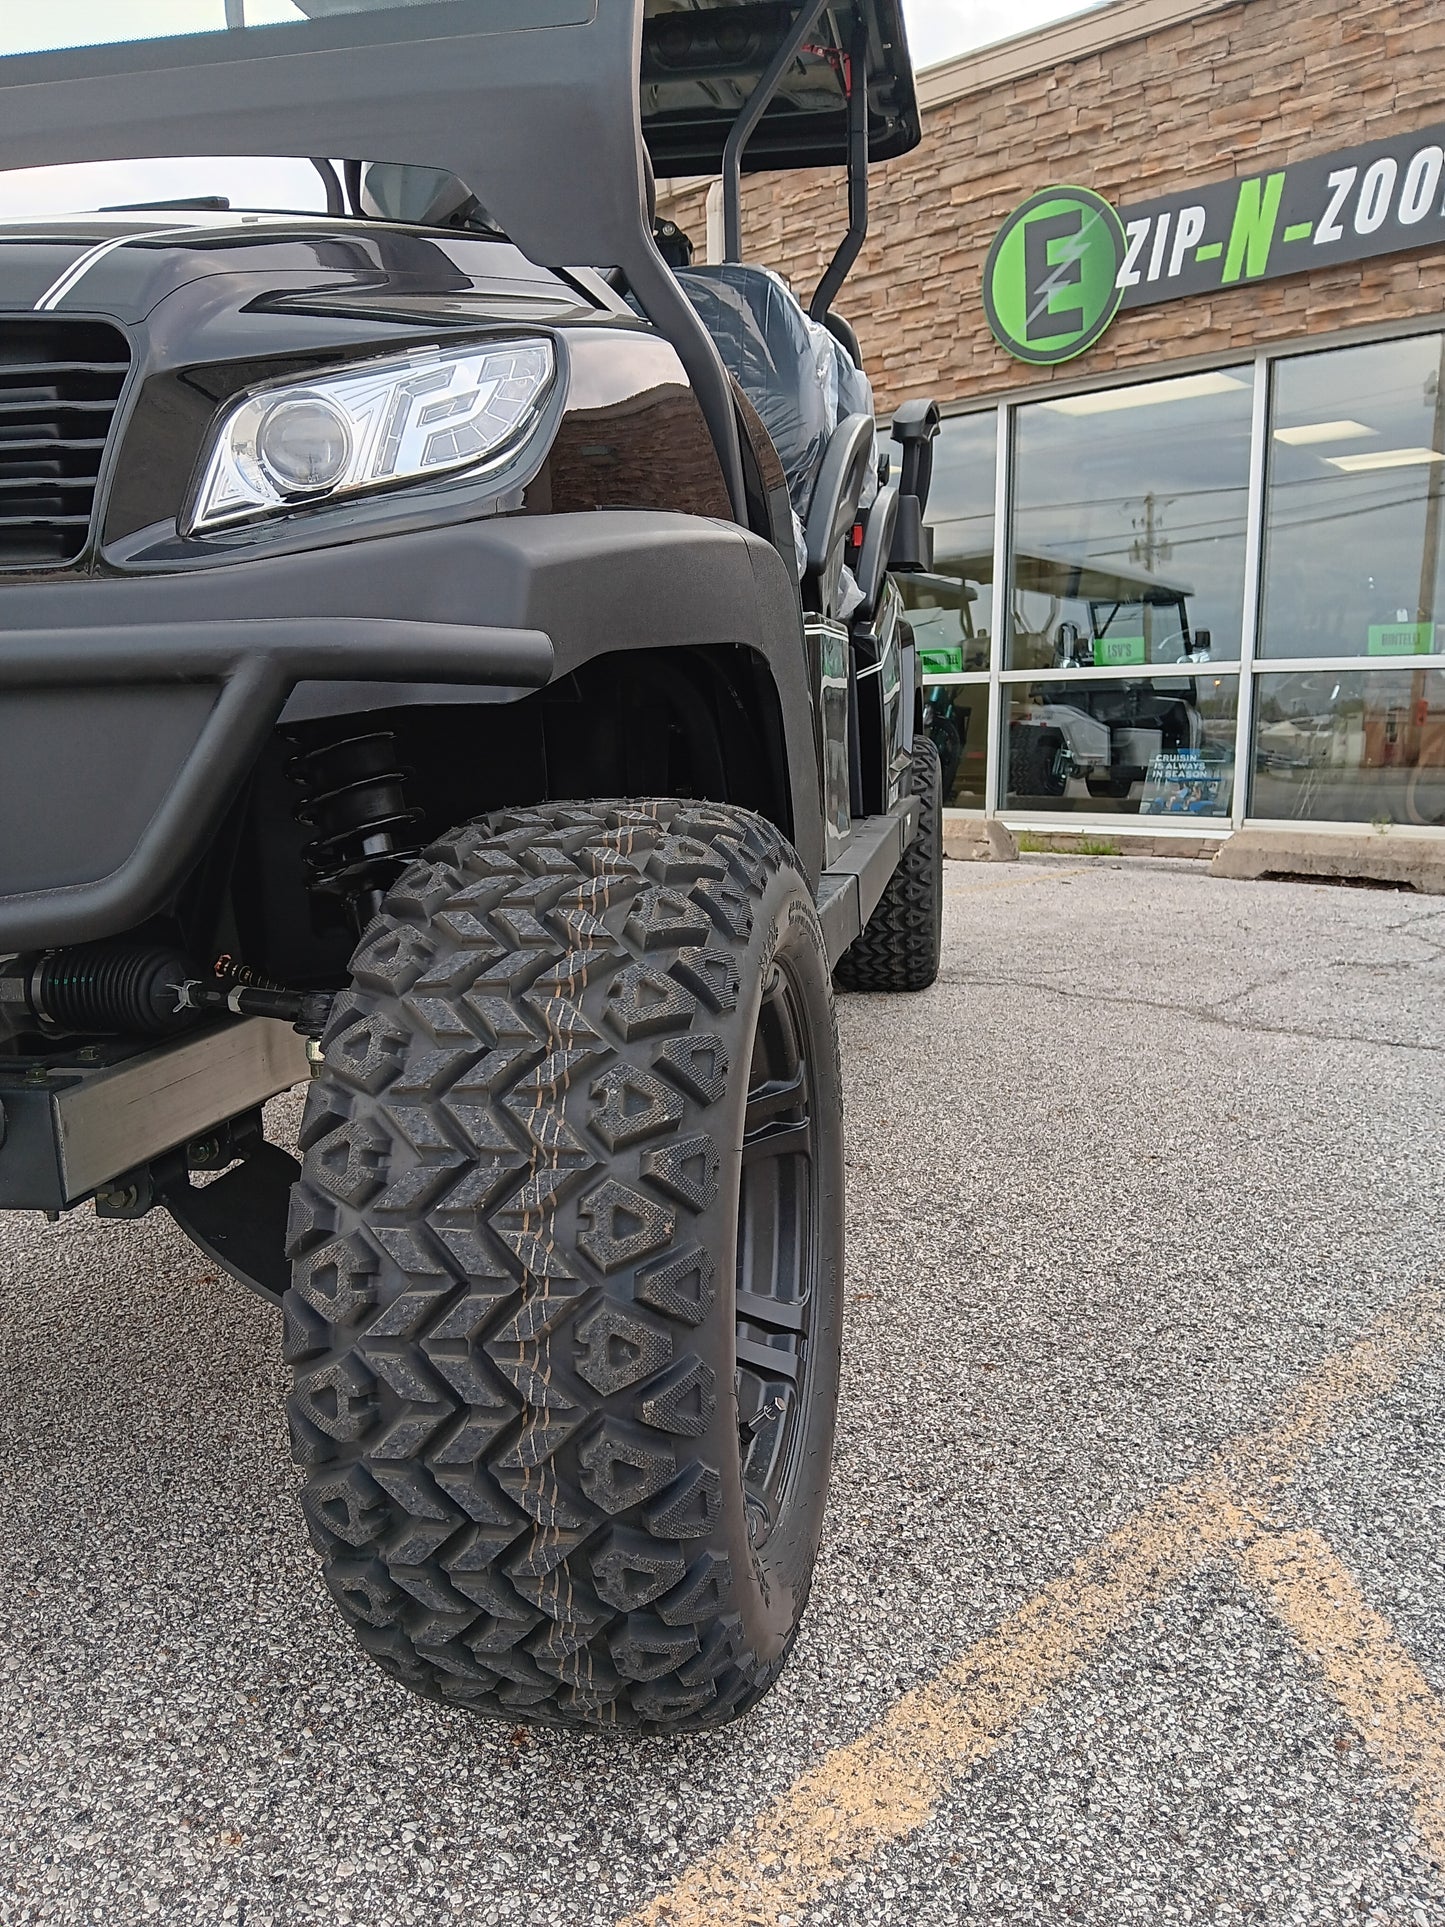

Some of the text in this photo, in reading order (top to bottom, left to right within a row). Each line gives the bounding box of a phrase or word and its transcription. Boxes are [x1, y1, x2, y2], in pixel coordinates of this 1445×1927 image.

[1115, 145, 1445, 289] ZIP-N-ZOO
[1024, 208, 1084, 342] E
[1155, 754, 1200, 762] CRUISIN'
[1154, 762, 1206, 770] IS ALWAYS
[1152, 770, 1208, 779] IN SEASON
